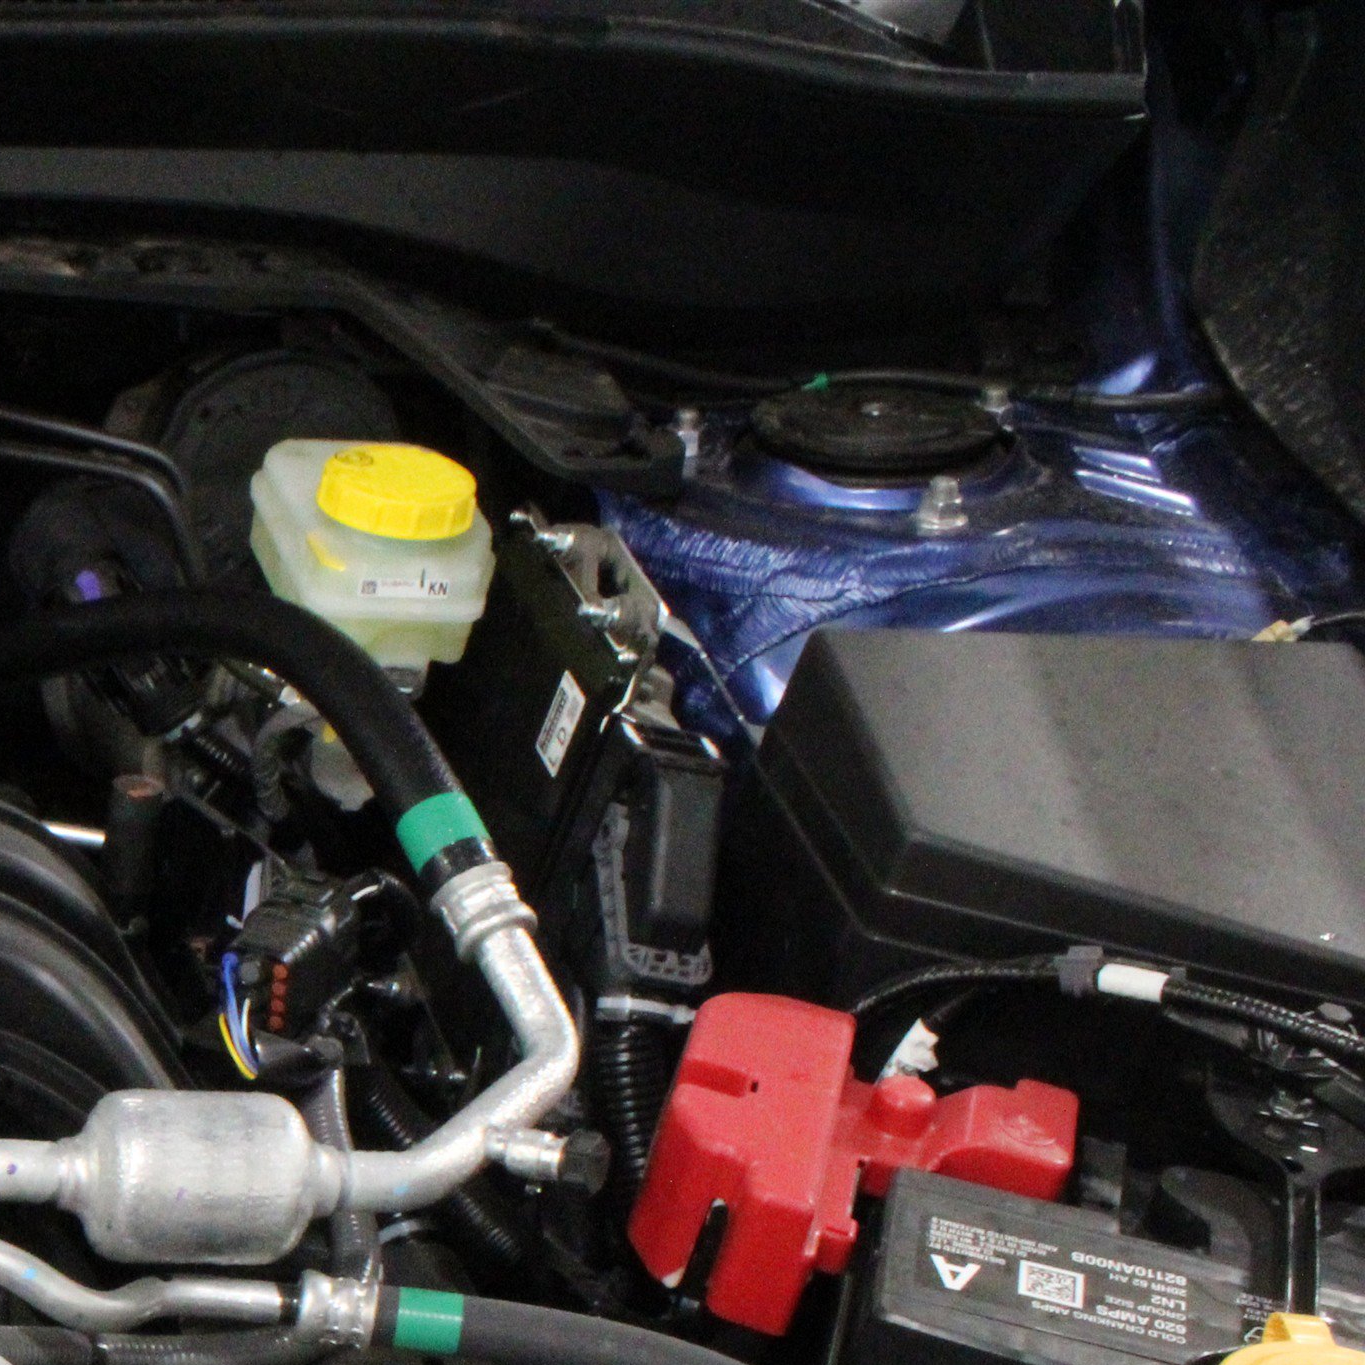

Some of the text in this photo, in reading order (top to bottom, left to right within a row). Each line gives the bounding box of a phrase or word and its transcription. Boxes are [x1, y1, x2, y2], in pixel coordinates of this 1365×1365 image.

[1071, 1251, 1187, 1286] 82110AN00B
[1109, 1272, 1129, 1283] AH
[1150, 1282, 1187, 1297] 20HR
[1150, 1294, 1187, 1311] LN2
[1095, 1304, 1187, 1335] 620 AMPS
[1104, 1294, 1187, 1321] GROUP SIZE
[1031, 1300, 1187, 1345] COLD CRANKING AMPS
